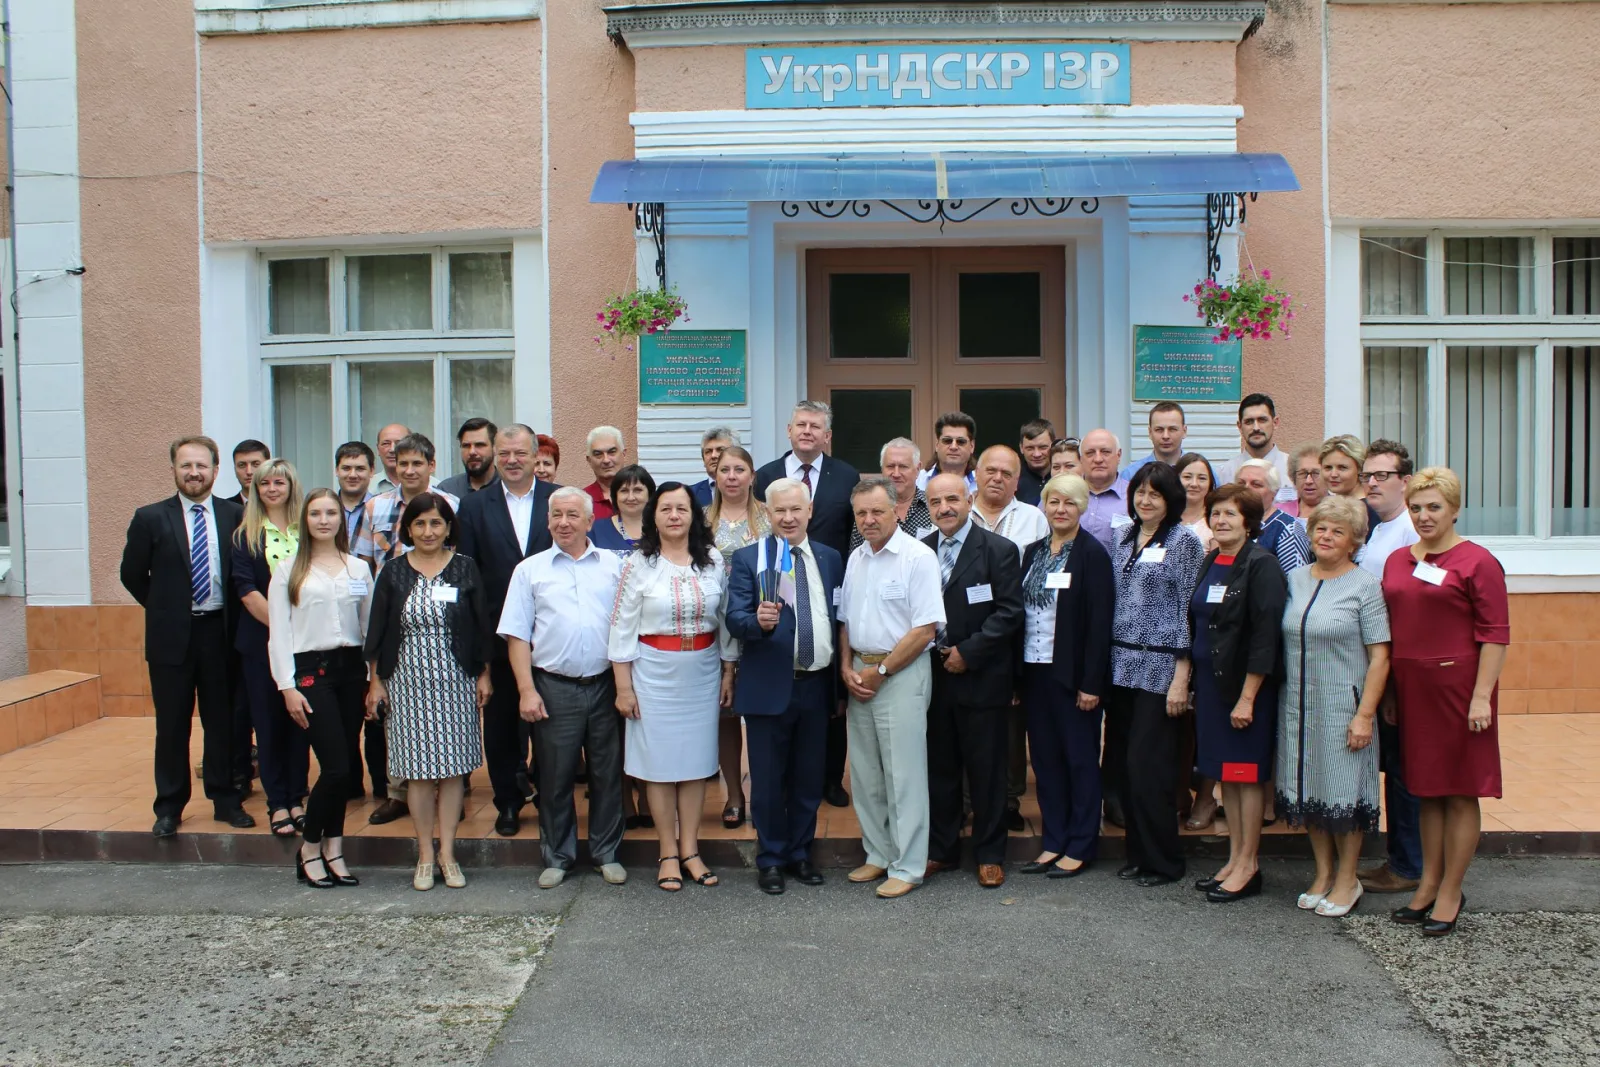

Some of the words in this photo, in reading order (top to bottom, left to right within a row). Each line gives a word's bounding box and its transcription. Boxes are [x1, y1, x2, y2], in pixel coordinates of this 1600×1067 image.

[759, 51, 1031, 102] УкрНДСКР
[1043, 51, 1120, 91] ІЗР
[1163, 353, 1213, 361] UKRAINIAN
[646, 367, 689, 375] НАУКОВО
[694, 367, 742, 376] ДОСЛІДНА
[1140, 364, 1187, 372] SCIENTIFIC
[1190, 364, 1236, 373] RESEARCH
[647, 378, 685, 387] СТАНЦІЯ
[686, 378, 740, 386] КАРАНТИНУ
[1143, 374, 1173, 383] PLANT
[1174, 375, 1232, 384] QUARANTINE
[667, 389, 704, 397] РОСЛИН
[1161, 386, 1198, 394] STATION
[1199, 386, 1215, 394] PPI
